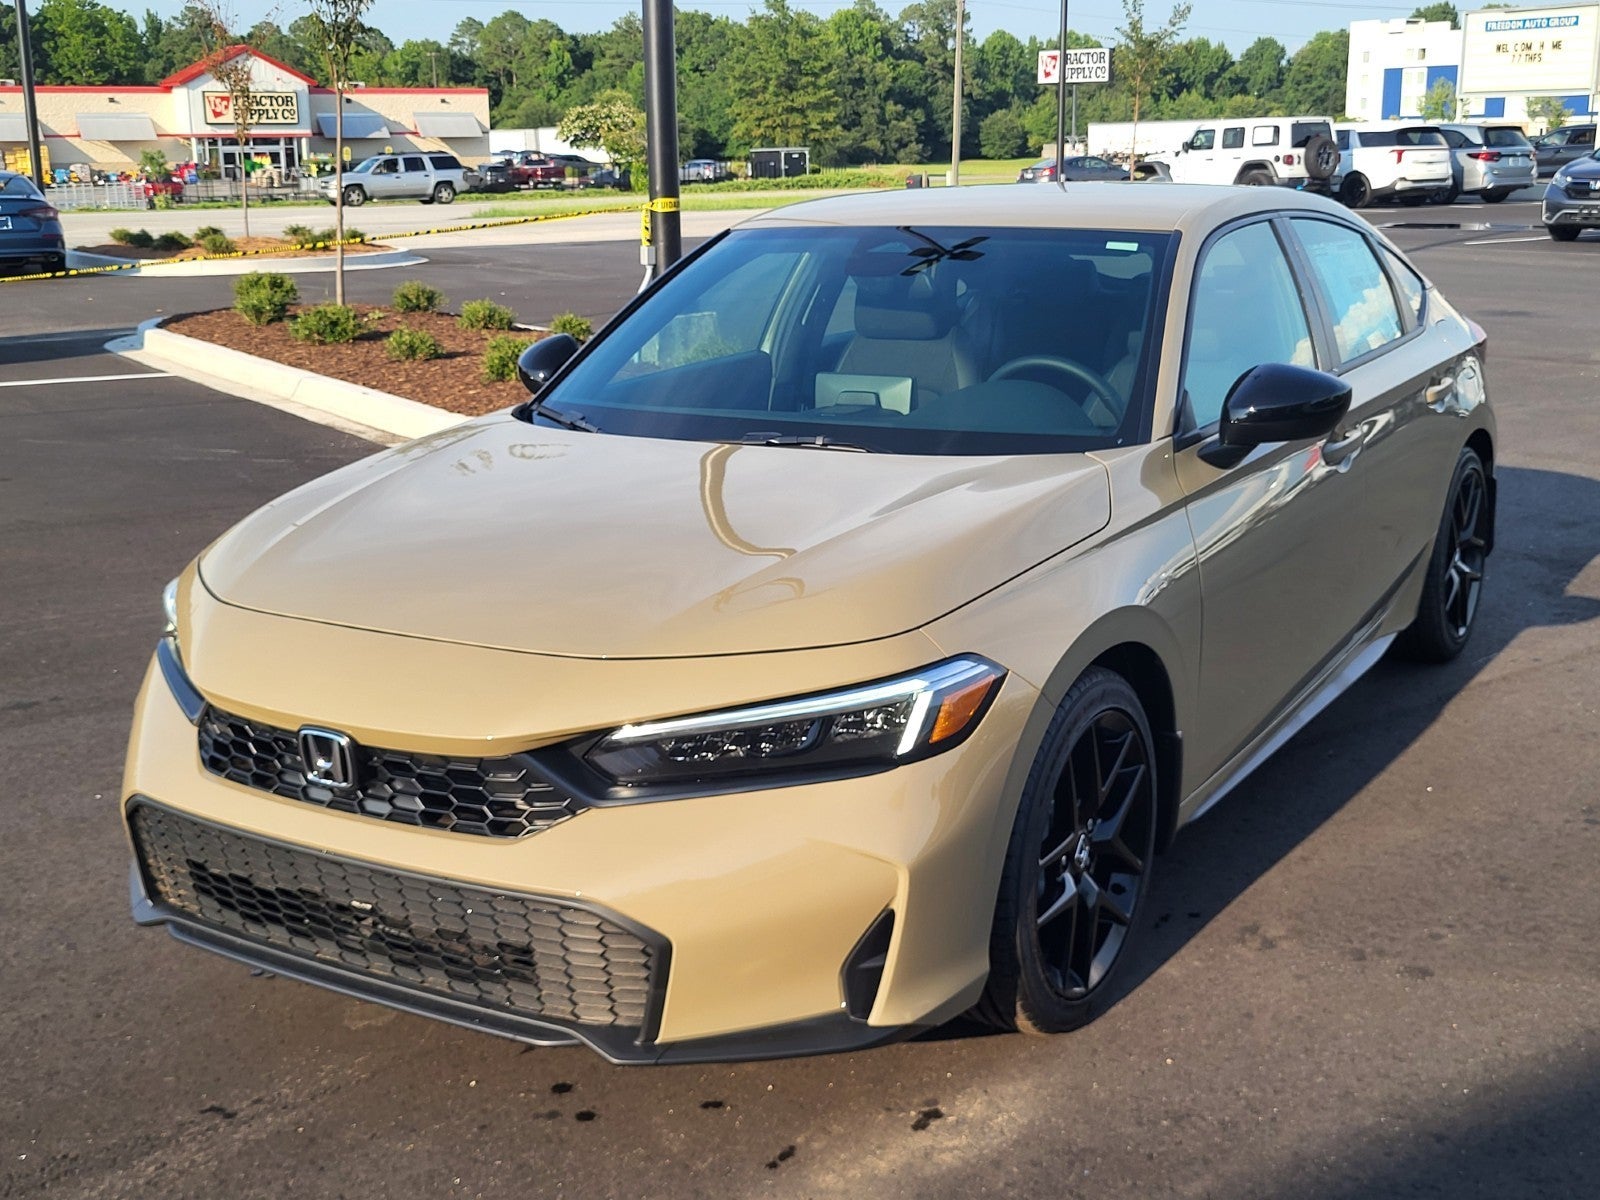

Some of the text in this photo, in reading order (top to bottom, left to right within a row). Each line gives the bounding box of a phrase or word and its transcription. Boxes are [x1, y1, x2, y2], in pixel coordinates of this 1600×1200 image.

[1487, 17, 1576, 30] FREEDOM AUTO GROUP
[1065, 52, 1106, 65] RACTOR
[207, 96, 230, 115] TSC
